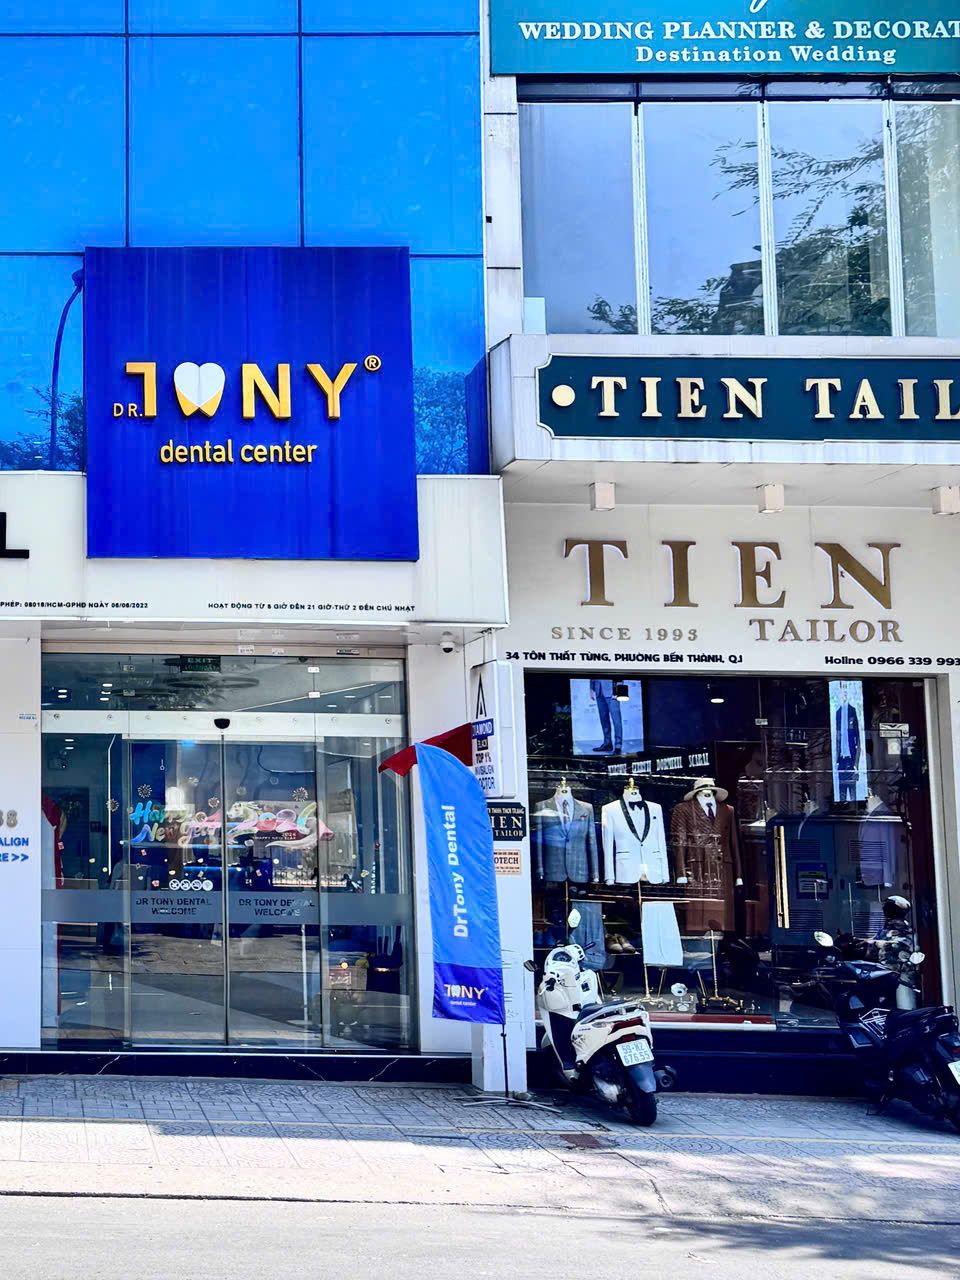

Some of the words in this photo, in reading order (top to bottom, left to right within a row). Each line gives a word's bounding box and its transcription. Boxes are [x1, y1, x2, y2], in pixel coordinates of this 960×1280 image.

[519, 21, 654, 40] WEDDING
[663, 21, 796, 39] PLANNER
[804, 21, 826, 39] &
[636, 45, 781, 63] Destination
[791, 45, 897, 65] Wedding
[591, 376, 768, 419] TIEN
[805, 377, 960, 420] TAIL
[113, 403, 143, 418] DR.
[160, 439, 234, 464] dental
[240, 440, 318, 464] center
[564, 539, 901, 609] TIEN
[551, 626, 632, 641] SINCE
[645, 628, 699, 642] 1993
[749, 618, 904, 643] TAILOR
[505, 651, 520, 660] 34
[523, 650, 546, 661] TÔN
[549, 649, 577, 661] THẤT
[867, 656, 905, 665] 0966
[908, 656, 933, 666] 339
[490, 815, 523, 829] IEN
[441, 805, 459, 866] Dental
[493, 856, 519, 865] OTECH
[151, 898, 174, 906] TONY
[254, 899, 278, 907] TONY
